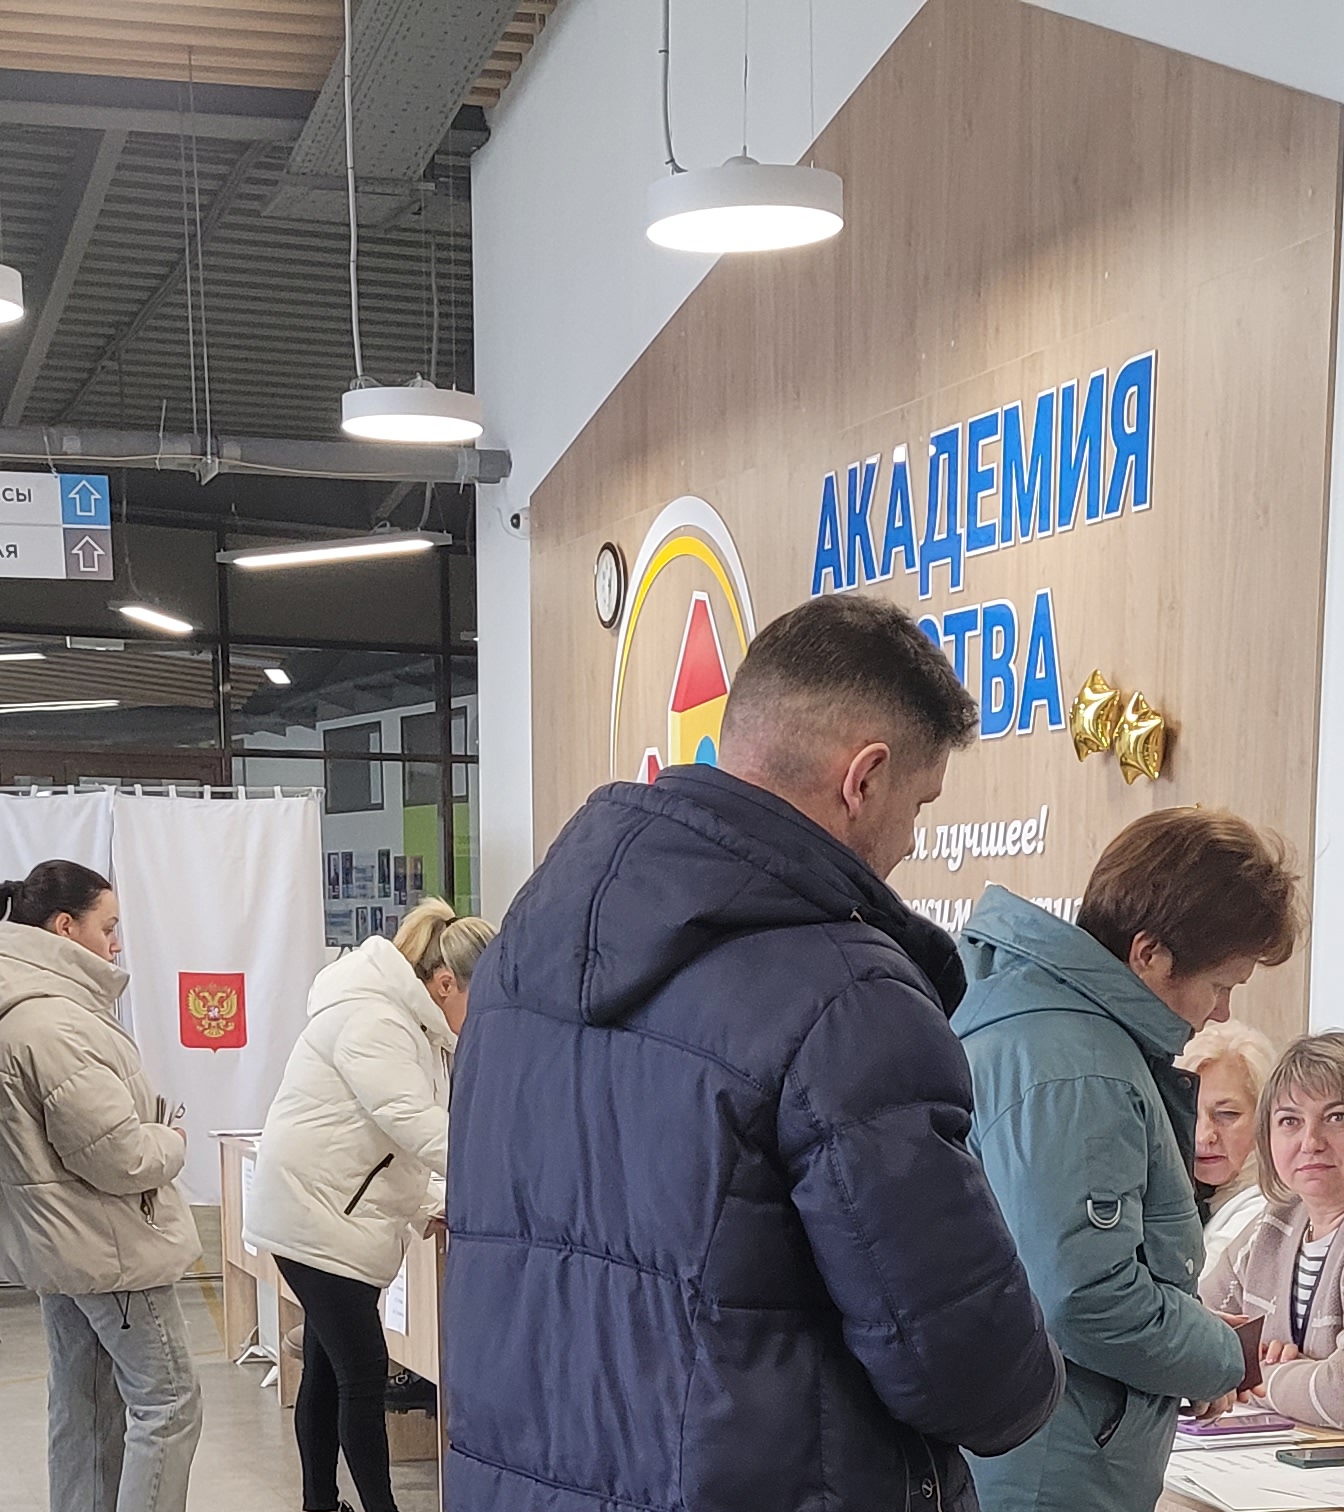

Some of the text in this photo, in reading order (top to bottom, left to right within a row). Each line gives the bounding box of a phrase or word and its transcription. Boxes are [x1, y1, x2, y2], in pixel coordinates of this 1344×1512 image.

[810, 349, 1158, 599] АКАДЕМИЯ
[917, 587, 1067, 740] ТВА
[931, 804, 1049, 873] лучшее!
